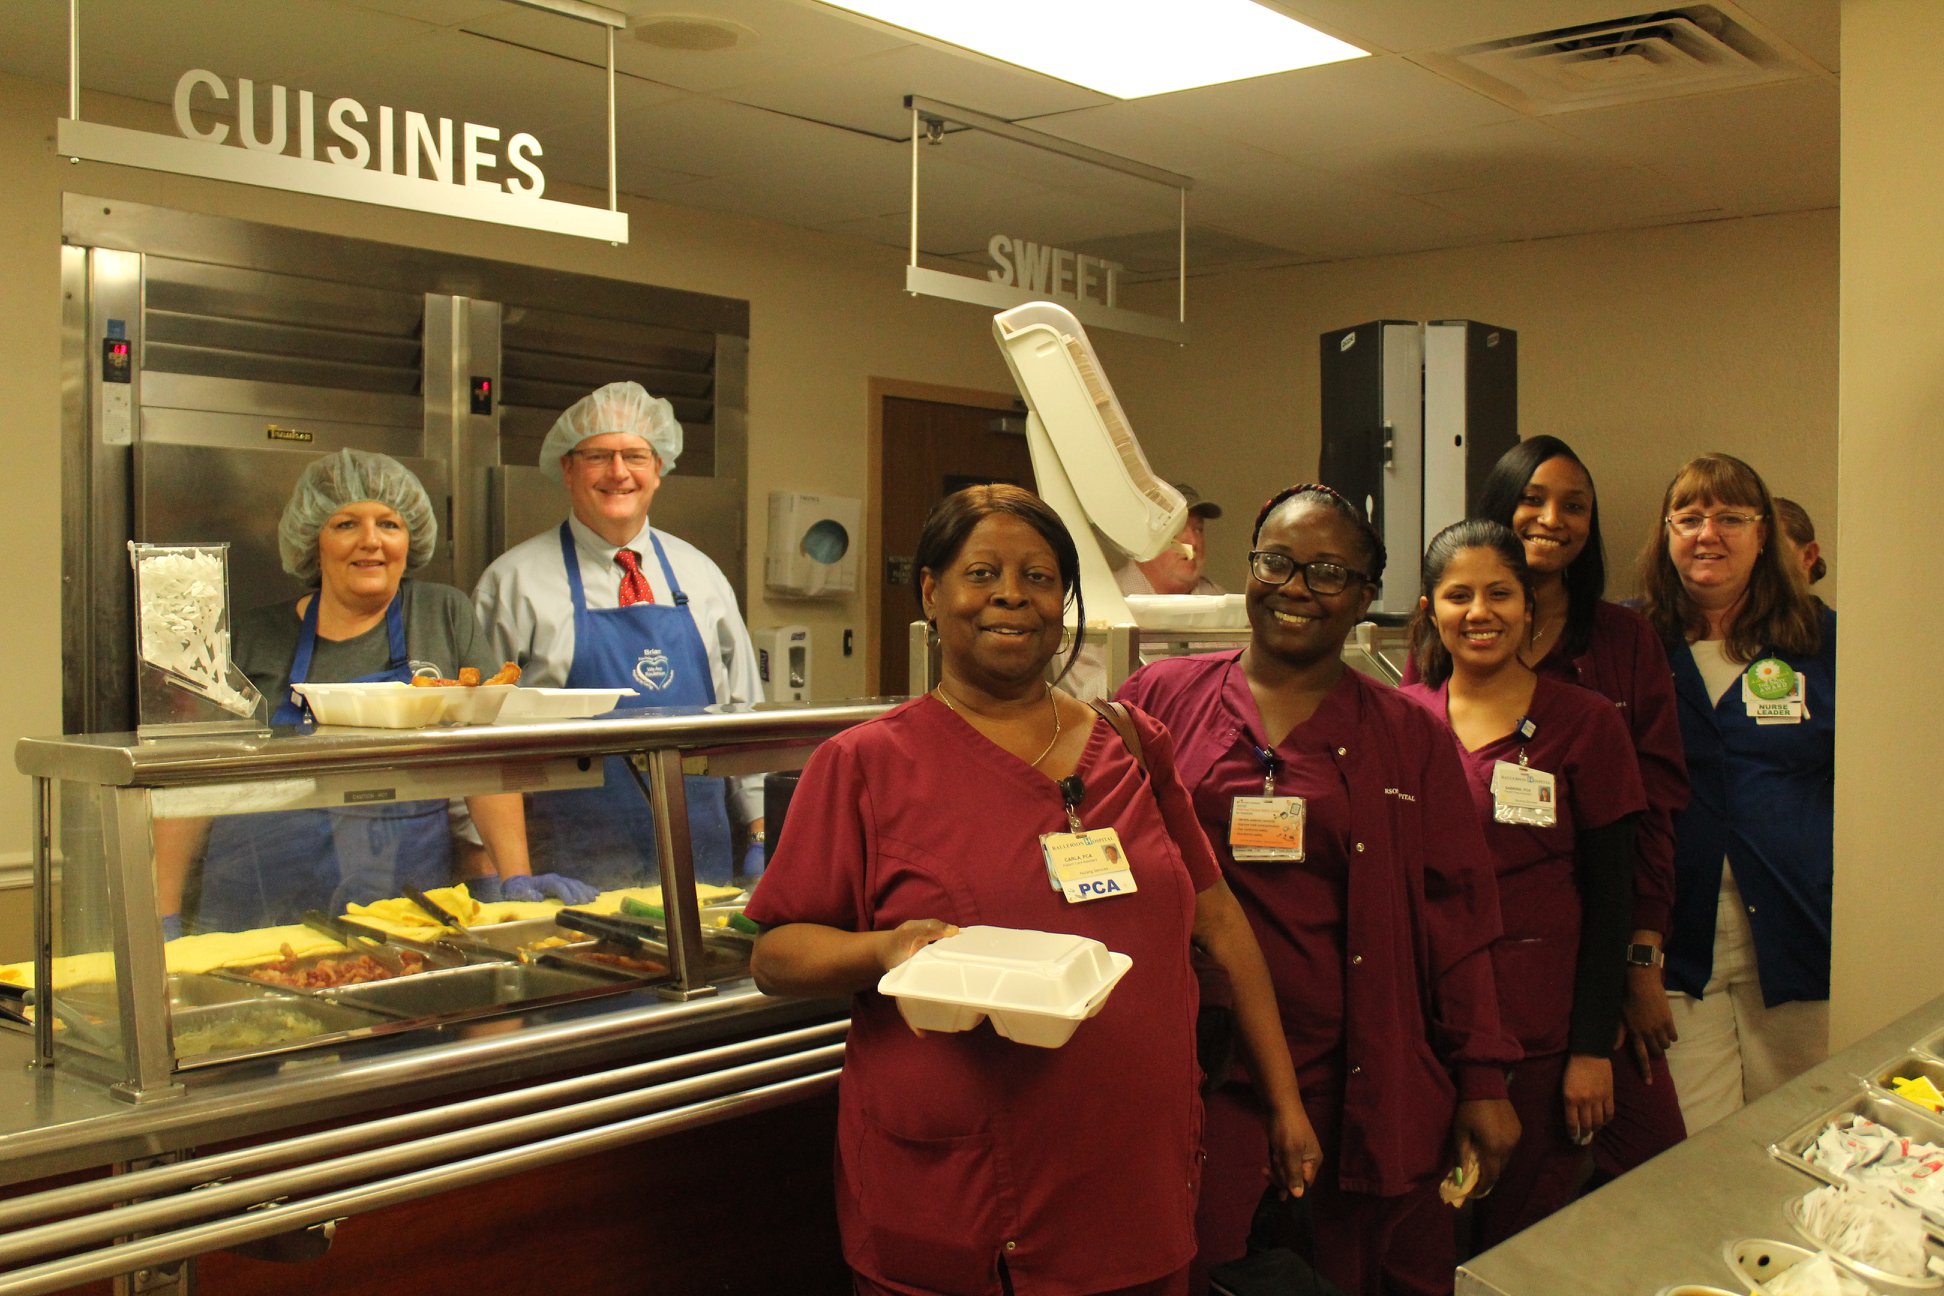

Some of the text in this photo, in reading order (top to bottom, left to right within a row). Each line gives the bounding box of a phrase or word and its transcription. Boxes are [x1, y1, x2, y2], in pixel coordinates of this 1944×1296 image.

[173, 68, 546, 200] CUISINES
[987, 234, 1125, 309] SWEET
[1078, 879, 1121, 896] PCA
